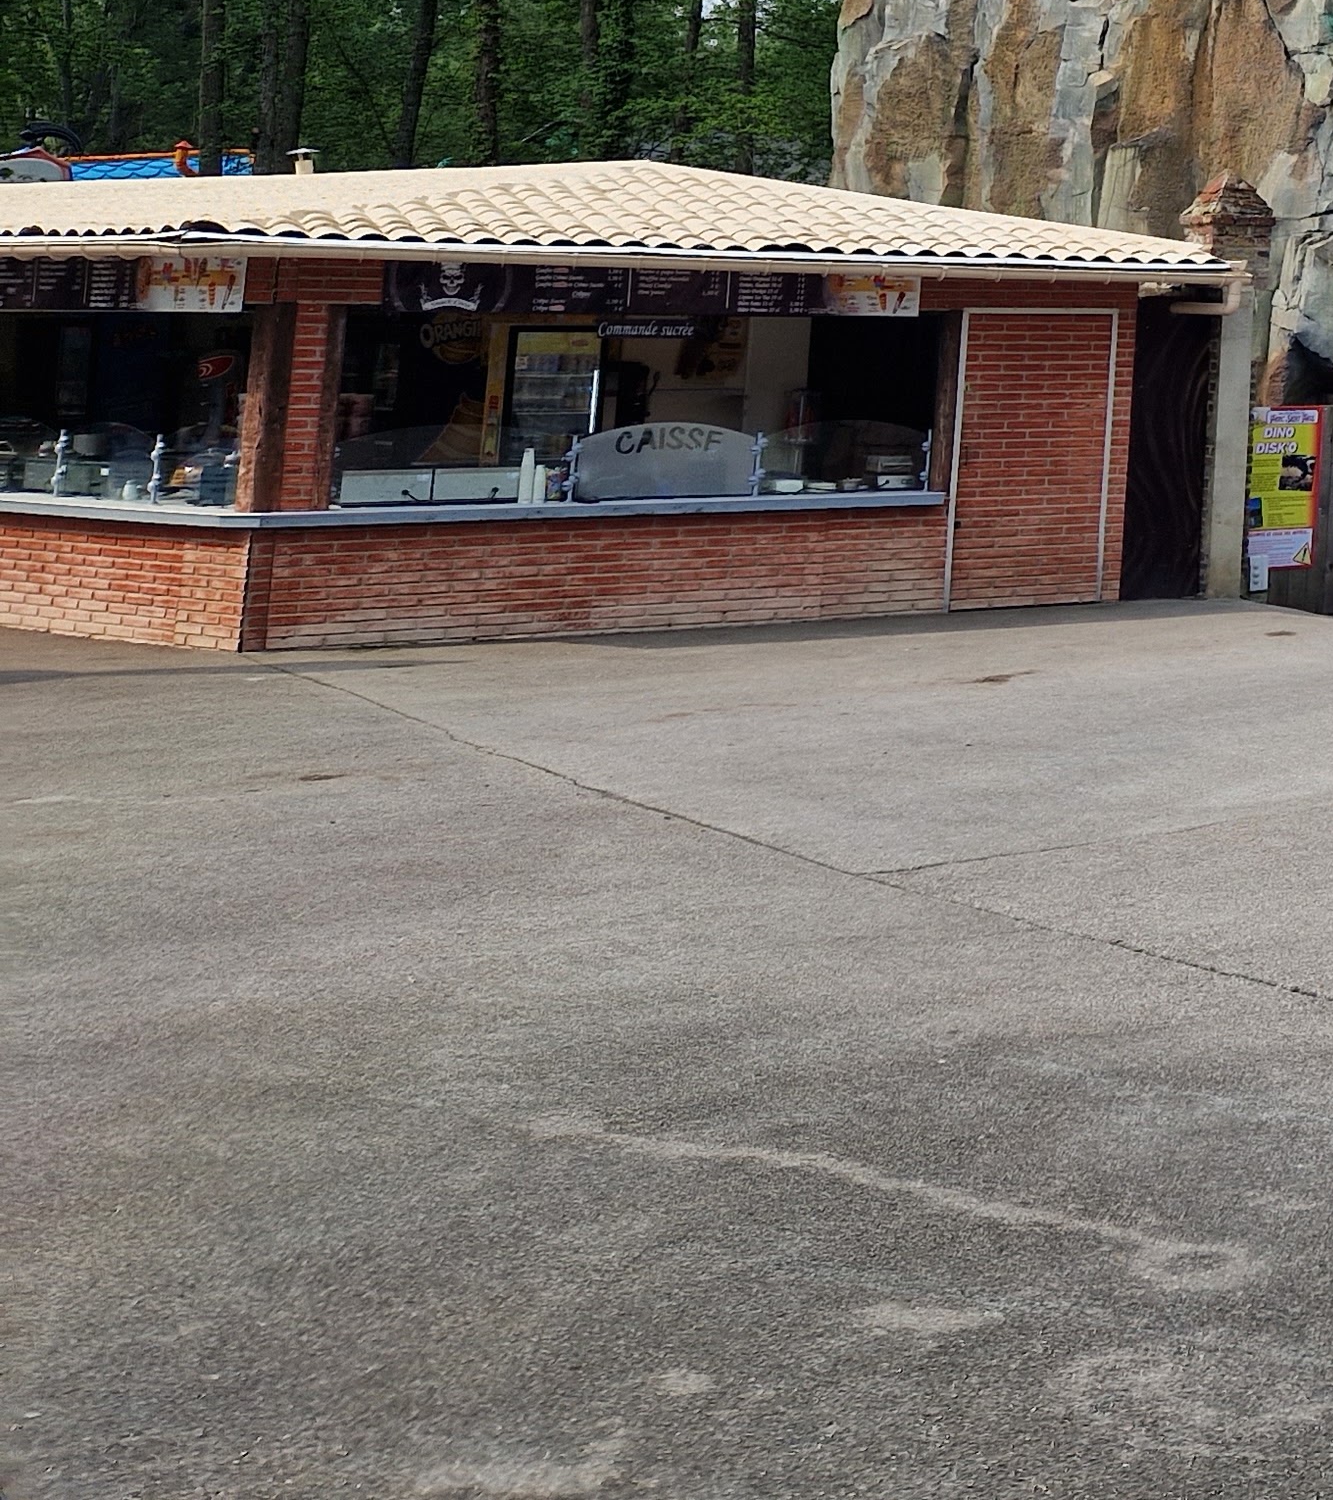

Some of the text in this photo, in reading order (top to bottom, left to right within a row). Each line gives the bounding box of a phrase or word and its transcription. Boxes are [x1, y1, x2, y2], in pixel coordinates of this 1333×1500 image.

[598, 321, 695, 337] Commande sucrée
[615, 426, 724, 454] CAISSE
[1263, 427, 1296, 439] DINO
[1255, 442, 1298, 454] DISK'O
